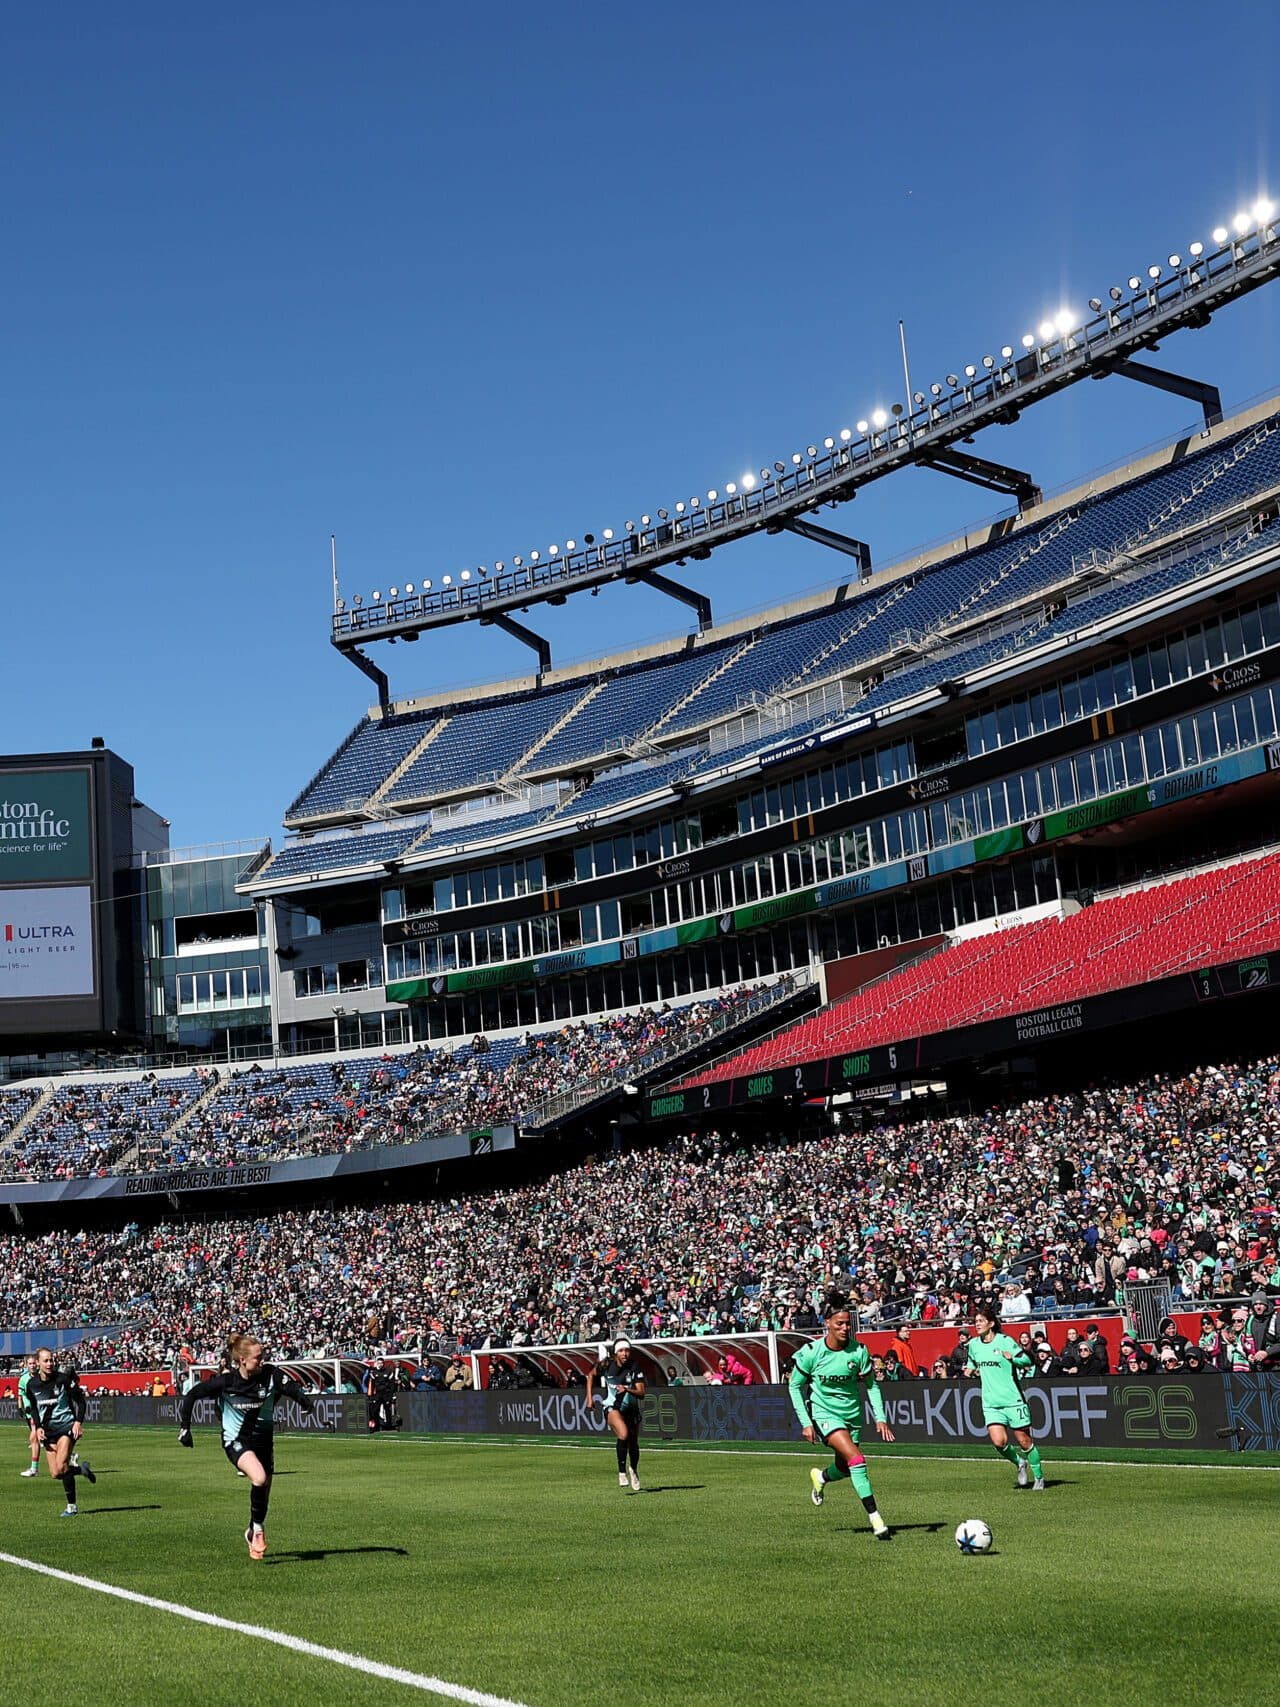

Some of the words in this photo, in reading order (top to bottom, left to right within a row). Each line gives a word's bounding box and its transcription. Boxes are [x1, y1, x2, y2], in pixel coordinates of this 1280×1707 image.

[1067, 808, 1101, 829] BOSTON
[1105, 791, 1137, 818] LEGACY
[1147, 790, 1157, 802] VS
[1164, 772, 1204, 799] GOTHAM
[1206, 766, 1218, 785] FC
[33, 843, 45, 851] for
[828, 879, 857, 898] GOTHAM
[858, 874, 870, 890] FC
[18, 926, 75, 939] ULTRA
[48, 945, 76, 953] BEER
[545, 956, 576, 972] GOTHAM
[577, 952, 586, 966] FC
[1203, 981, 1210, 996] 3
[1016, 1011, 1050, 1029] BOSTON
[1052, 1004, 1083, 1020] LEGACY
[1017, 1021, 1060, 1040] FOOTBALL
[1061, 1016, 1083, 1032] CLUB
[843, 1054, 870, 1078] SHOTS
[889, 1047, 897, 1070] 5
[748, 1075, 773, 1098] SAVES
[795, 1068, 803, 1089] 2
[651, 1094, 685, 1117] CORNERS
[703, 1087, 711, 1108] 2
[126, 1175, 167, 1194] READING
[168, 1172, 209, 1190] ROCKETS
[210, 1171, 228, 1187] ARE
[230, 1169, 245, 1185] THE
[247, 1165, 271, 1182] BEST!
[507, 1406, 539, 1423] NWSL
[538, 1395, 609, 1432] KICKO
[923, 1385, 1108, 1439] KICOFF
[1017, 1406, 1030, 1420] 20
